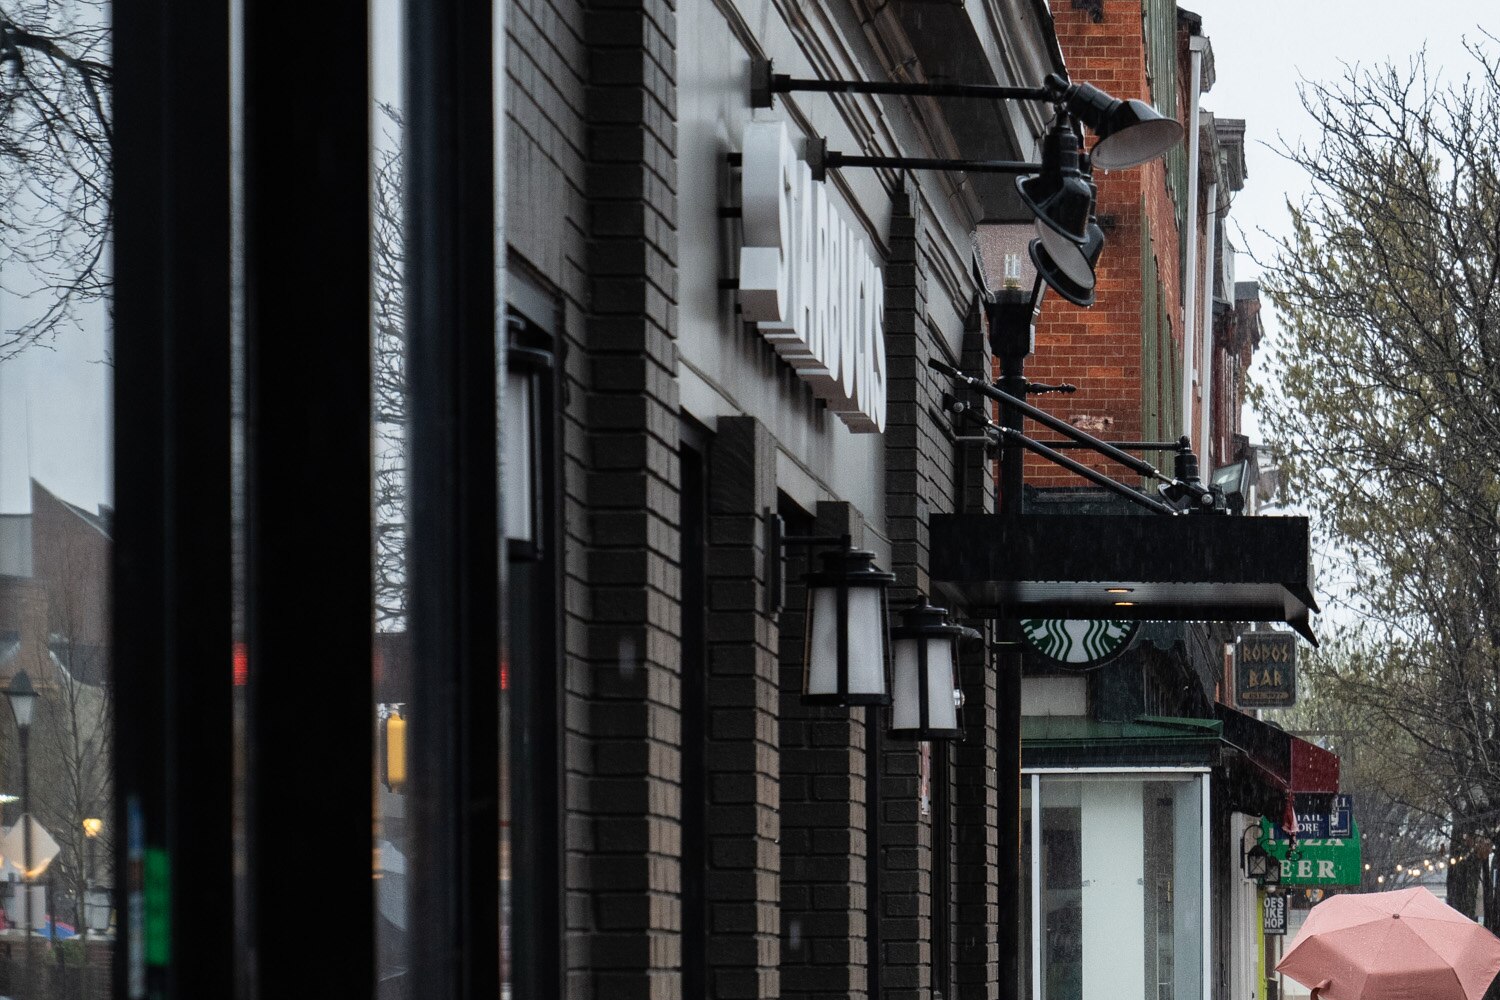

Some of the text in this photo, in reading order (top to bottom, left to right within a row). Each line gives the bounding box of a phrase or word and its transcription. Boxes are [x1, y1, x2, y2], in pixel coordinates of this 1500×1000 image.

[1242, 643, 1289, 663] RODOS
[1248, 669, 1282, 687] BAR
[1297, 823, 1319, 832] ORE
[1279, 860, 1336, 878] EER
[1264, 908, 1284, 918] IKE
[1264, 918, 1284, 929] HOP
